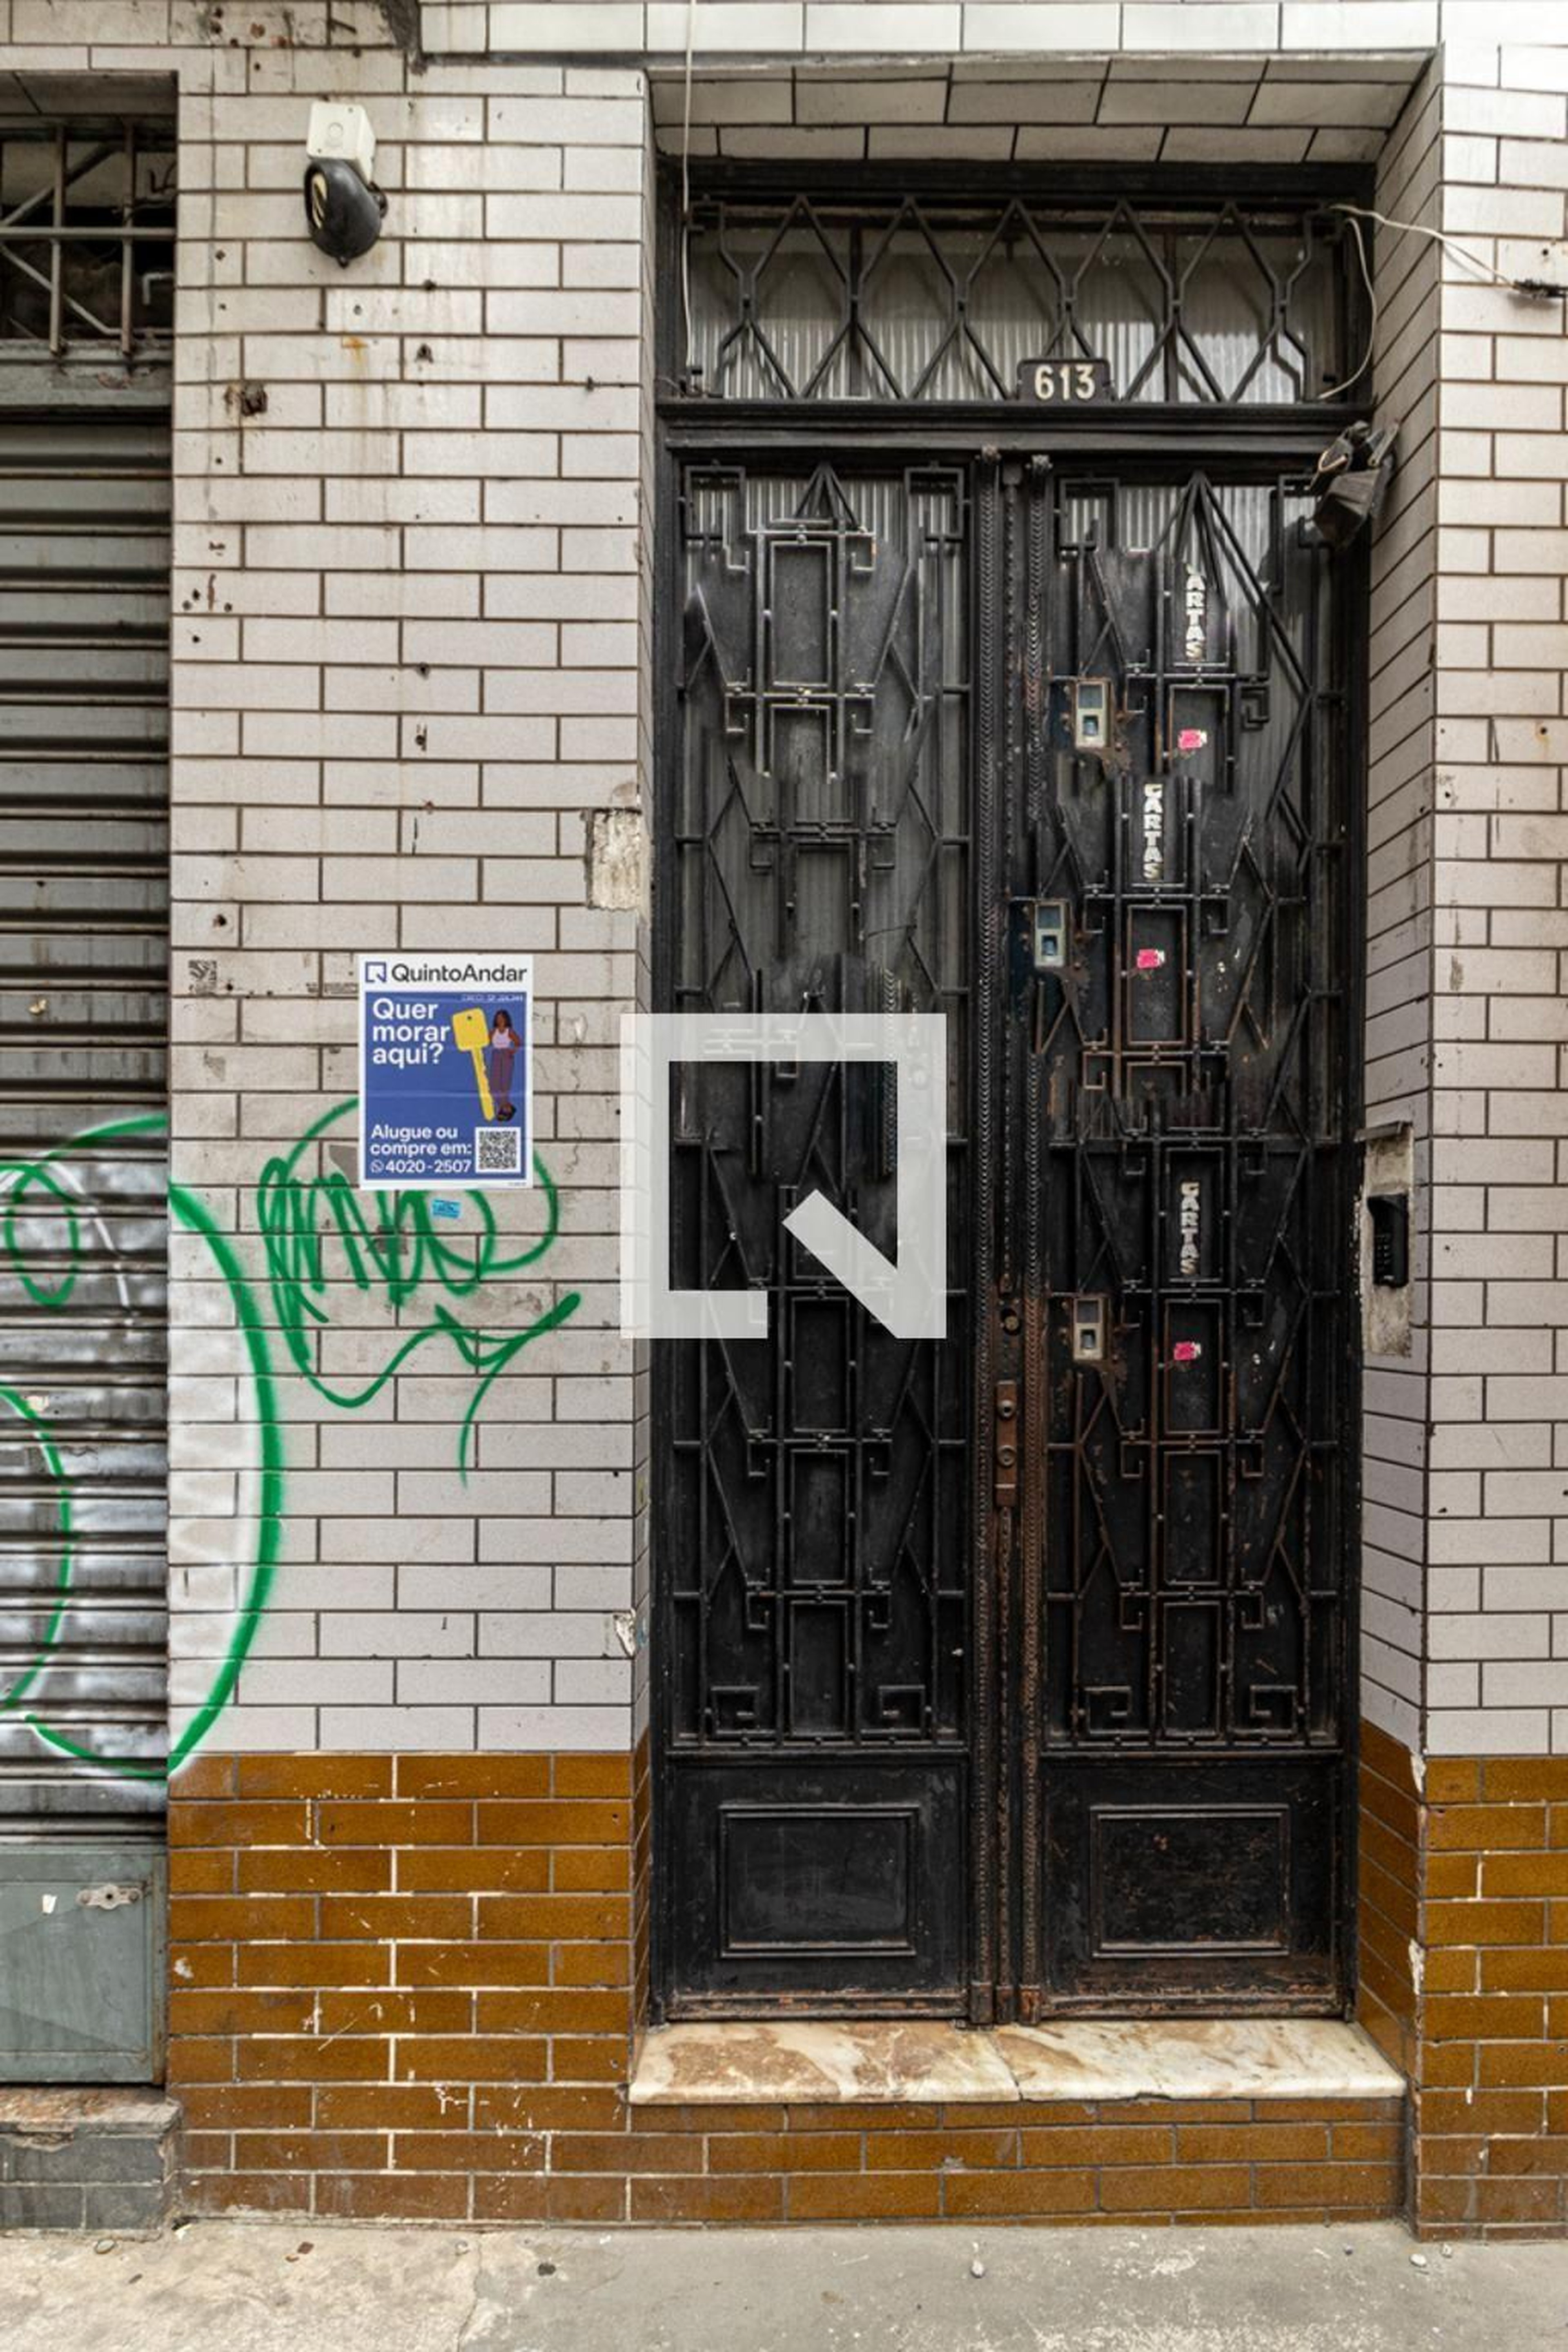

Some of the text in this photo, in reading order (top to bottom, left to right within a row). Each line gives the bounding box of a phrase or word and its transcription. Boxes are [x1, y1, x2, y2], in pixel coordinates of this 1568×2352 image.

[1035, 364, 1095, 400] 613
[1144, 783, 1163, 879] CARTAS
[392, 963, 527, 982] QuintoAndar
[373, 998, 438, 1020] Quer
[373, 1025, 450, 1042] morar
[373, 1042, 443, 1069] aqui?
[371, 1124, 458, 1142] Alugue ou
[370, 1143, 472, 1158] compre em:
[1180, 1182, 1200, 1274] CARTAS
